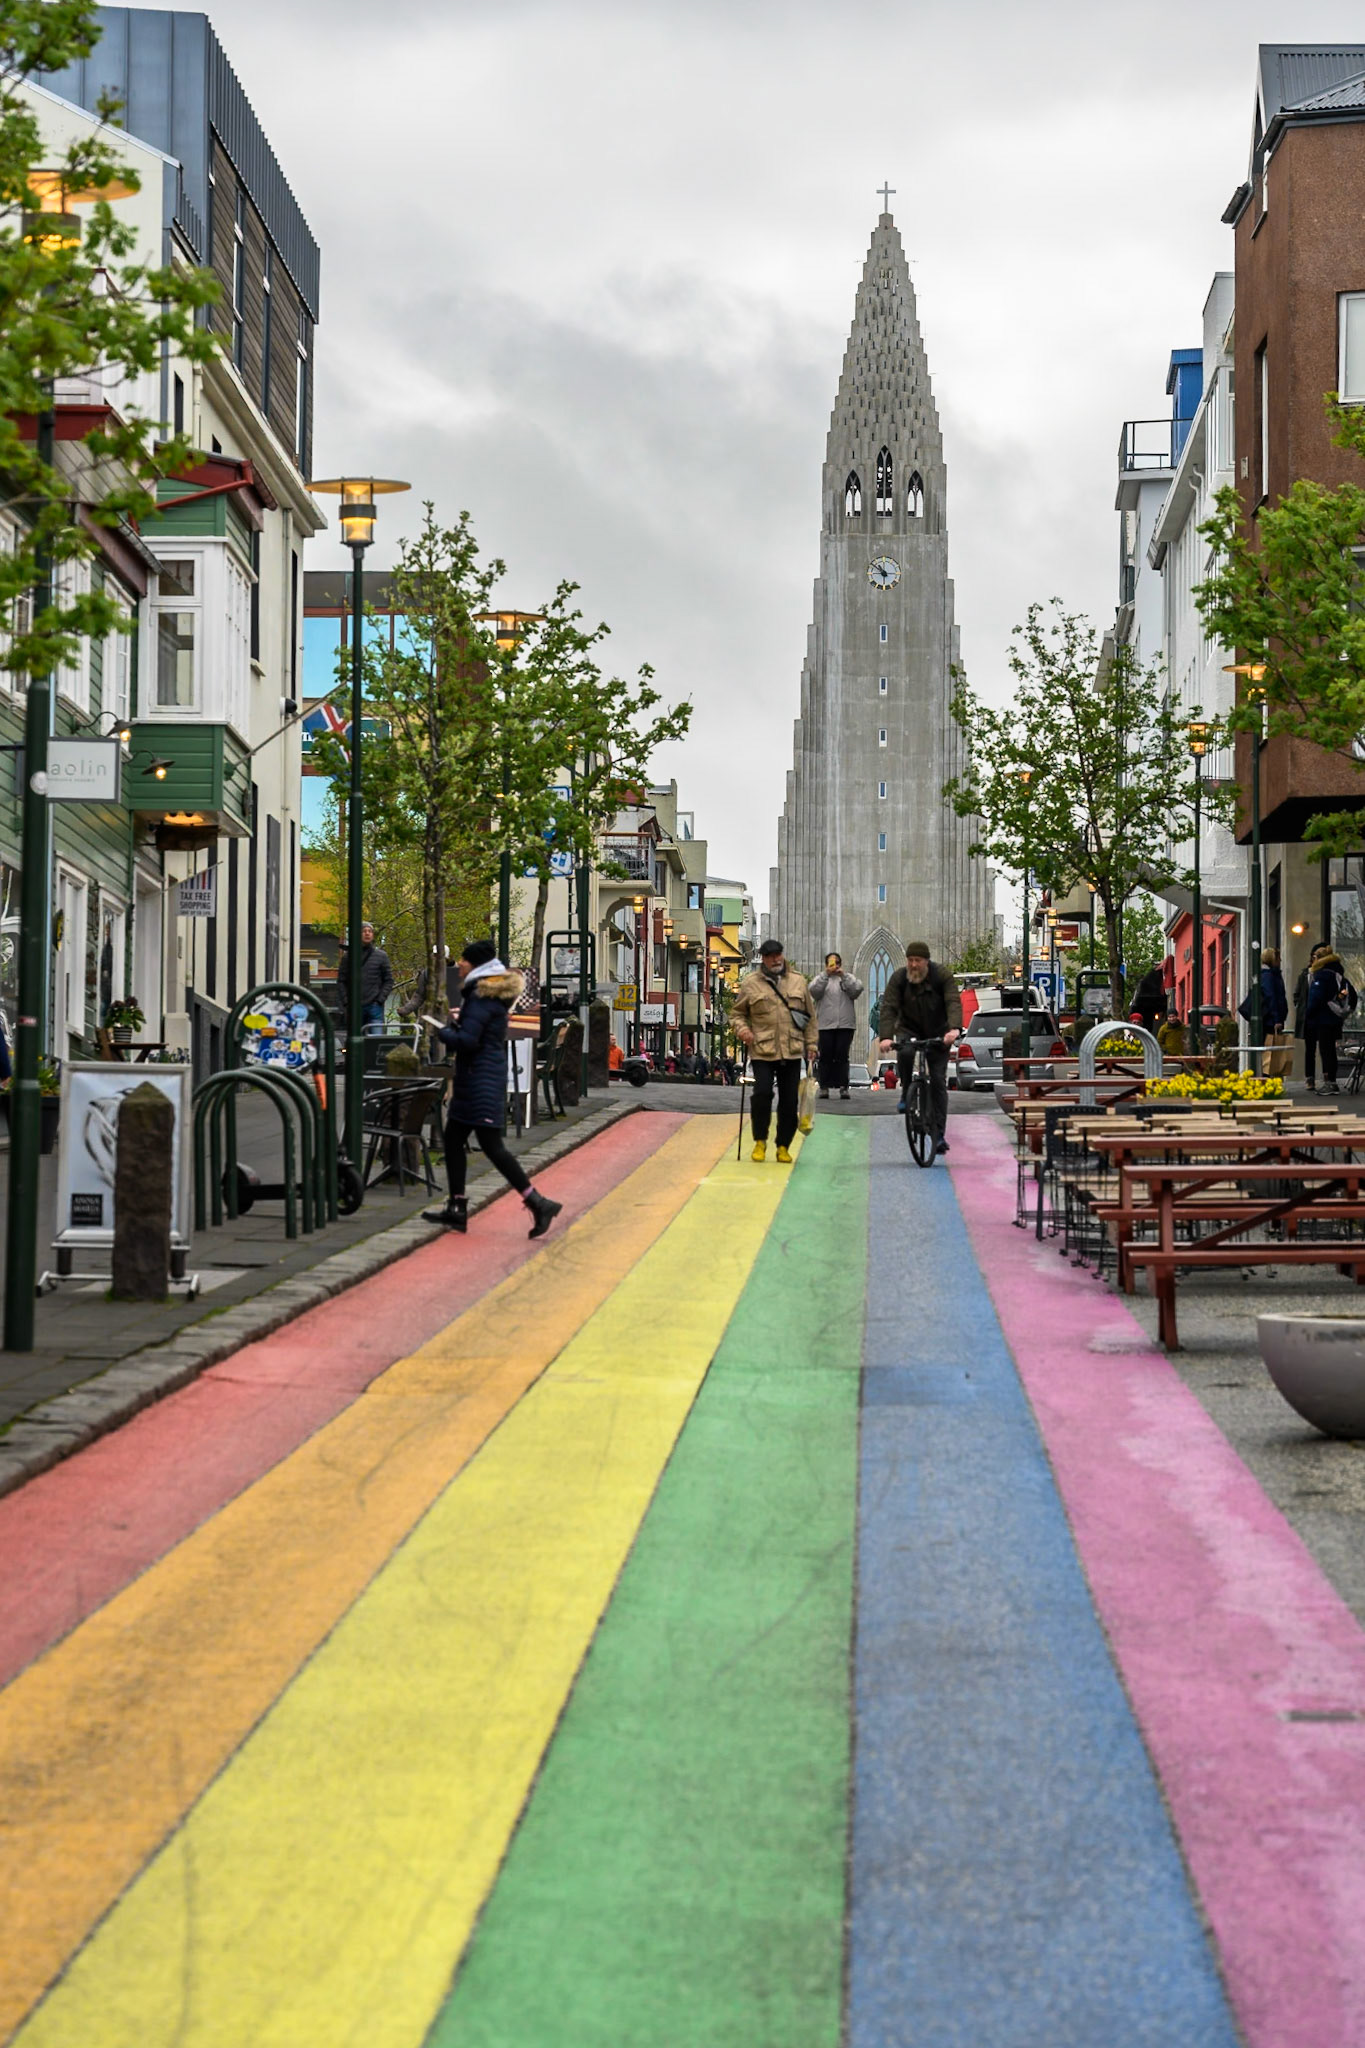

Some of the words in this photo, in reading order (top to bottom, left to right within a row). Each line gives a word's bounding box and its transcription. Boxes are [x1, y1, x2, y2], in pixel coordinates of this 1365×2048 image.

[49, 759, 106, 776] aolin
[180, 892, 192, 900] TAX
[195, 892, 211, 901] FREE
[179, 901, 211, 910] SHOPPING
[621, 987, 634, 999] 12
